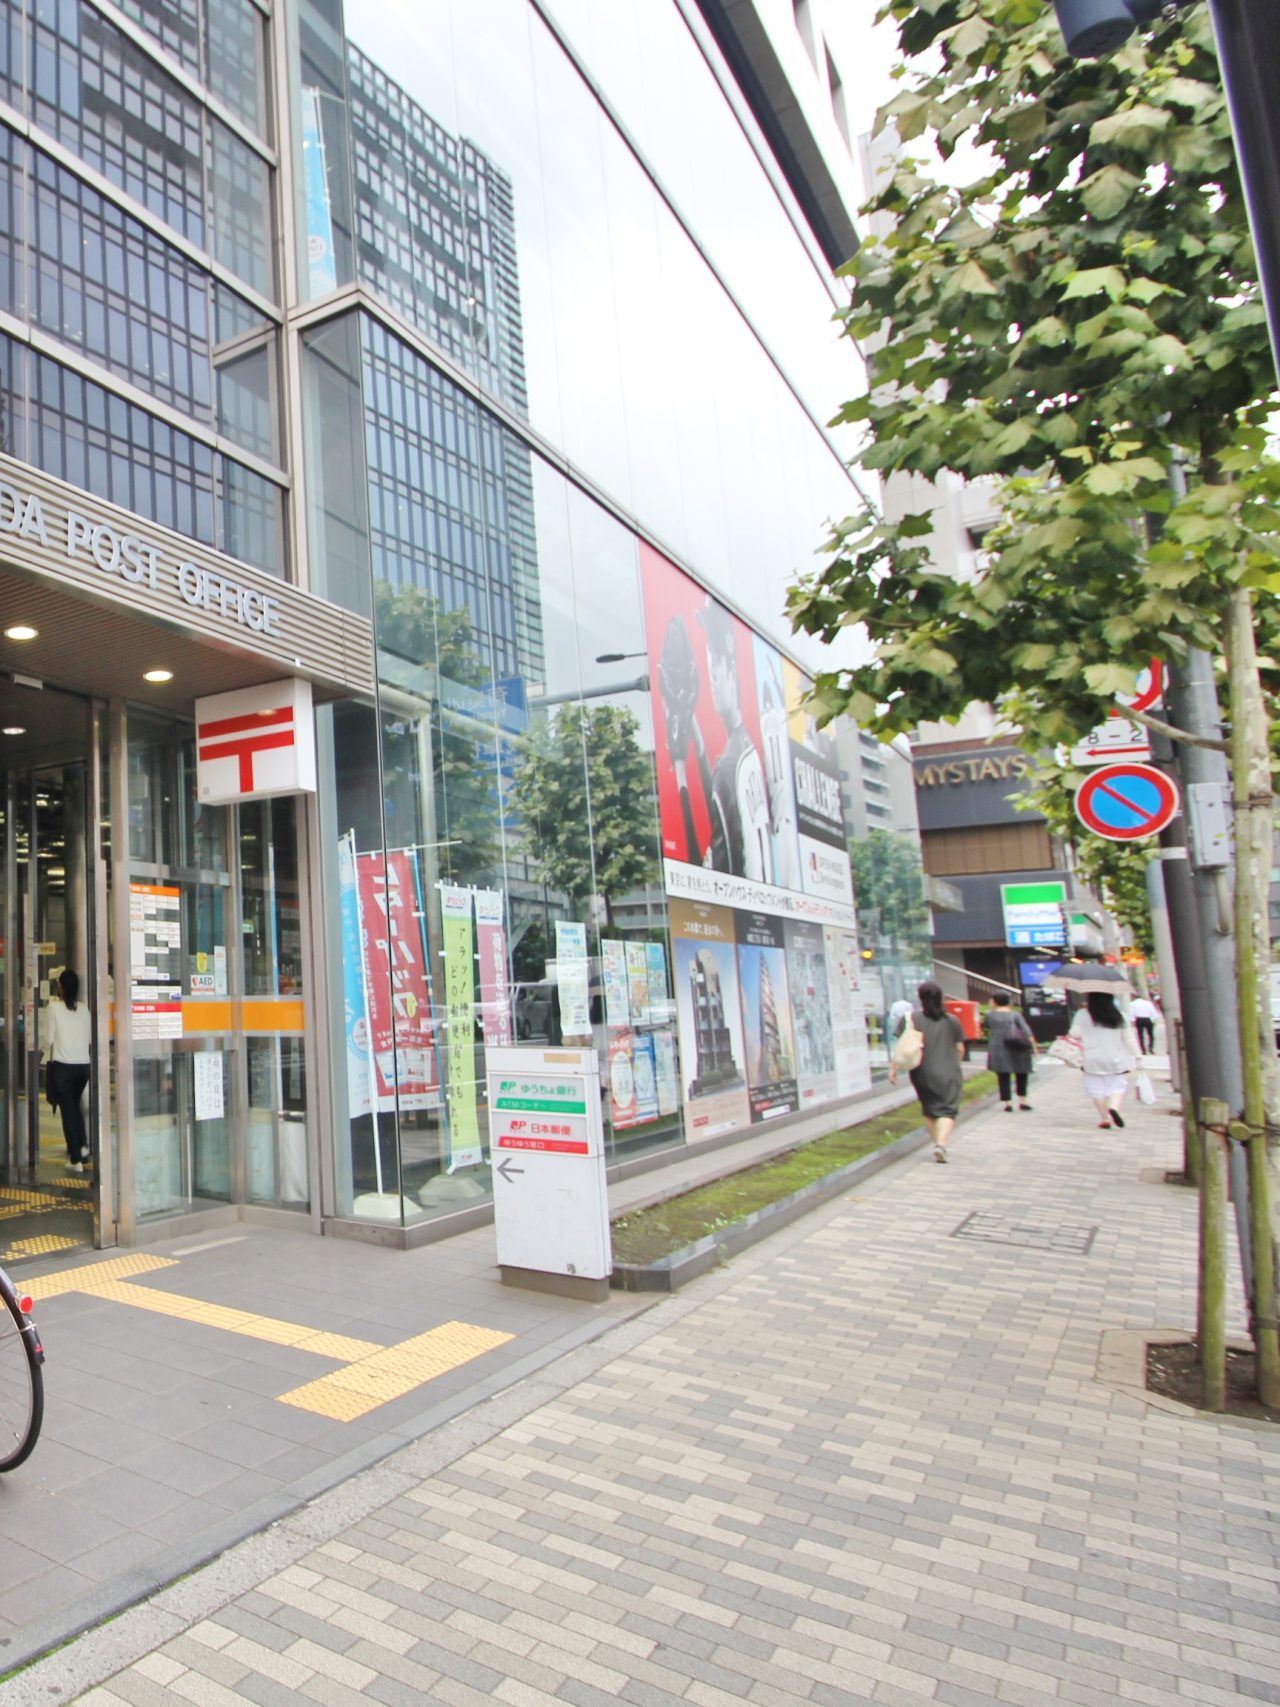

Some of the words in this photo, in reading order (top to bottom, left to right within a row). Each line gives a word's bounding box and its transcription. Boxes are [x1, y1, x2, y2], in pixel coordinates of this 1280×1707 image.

[67, 510, 164, 590] POST
[179, 561, 282, 638] OFFICE
[914, 754, 1029, 785] MYSTAYS
[198, 976, 213, 986] AED
[520, 1083, 577, 1096] ゆうちょ銀行
[531, 1123, 571, 1136] 日本郵便
